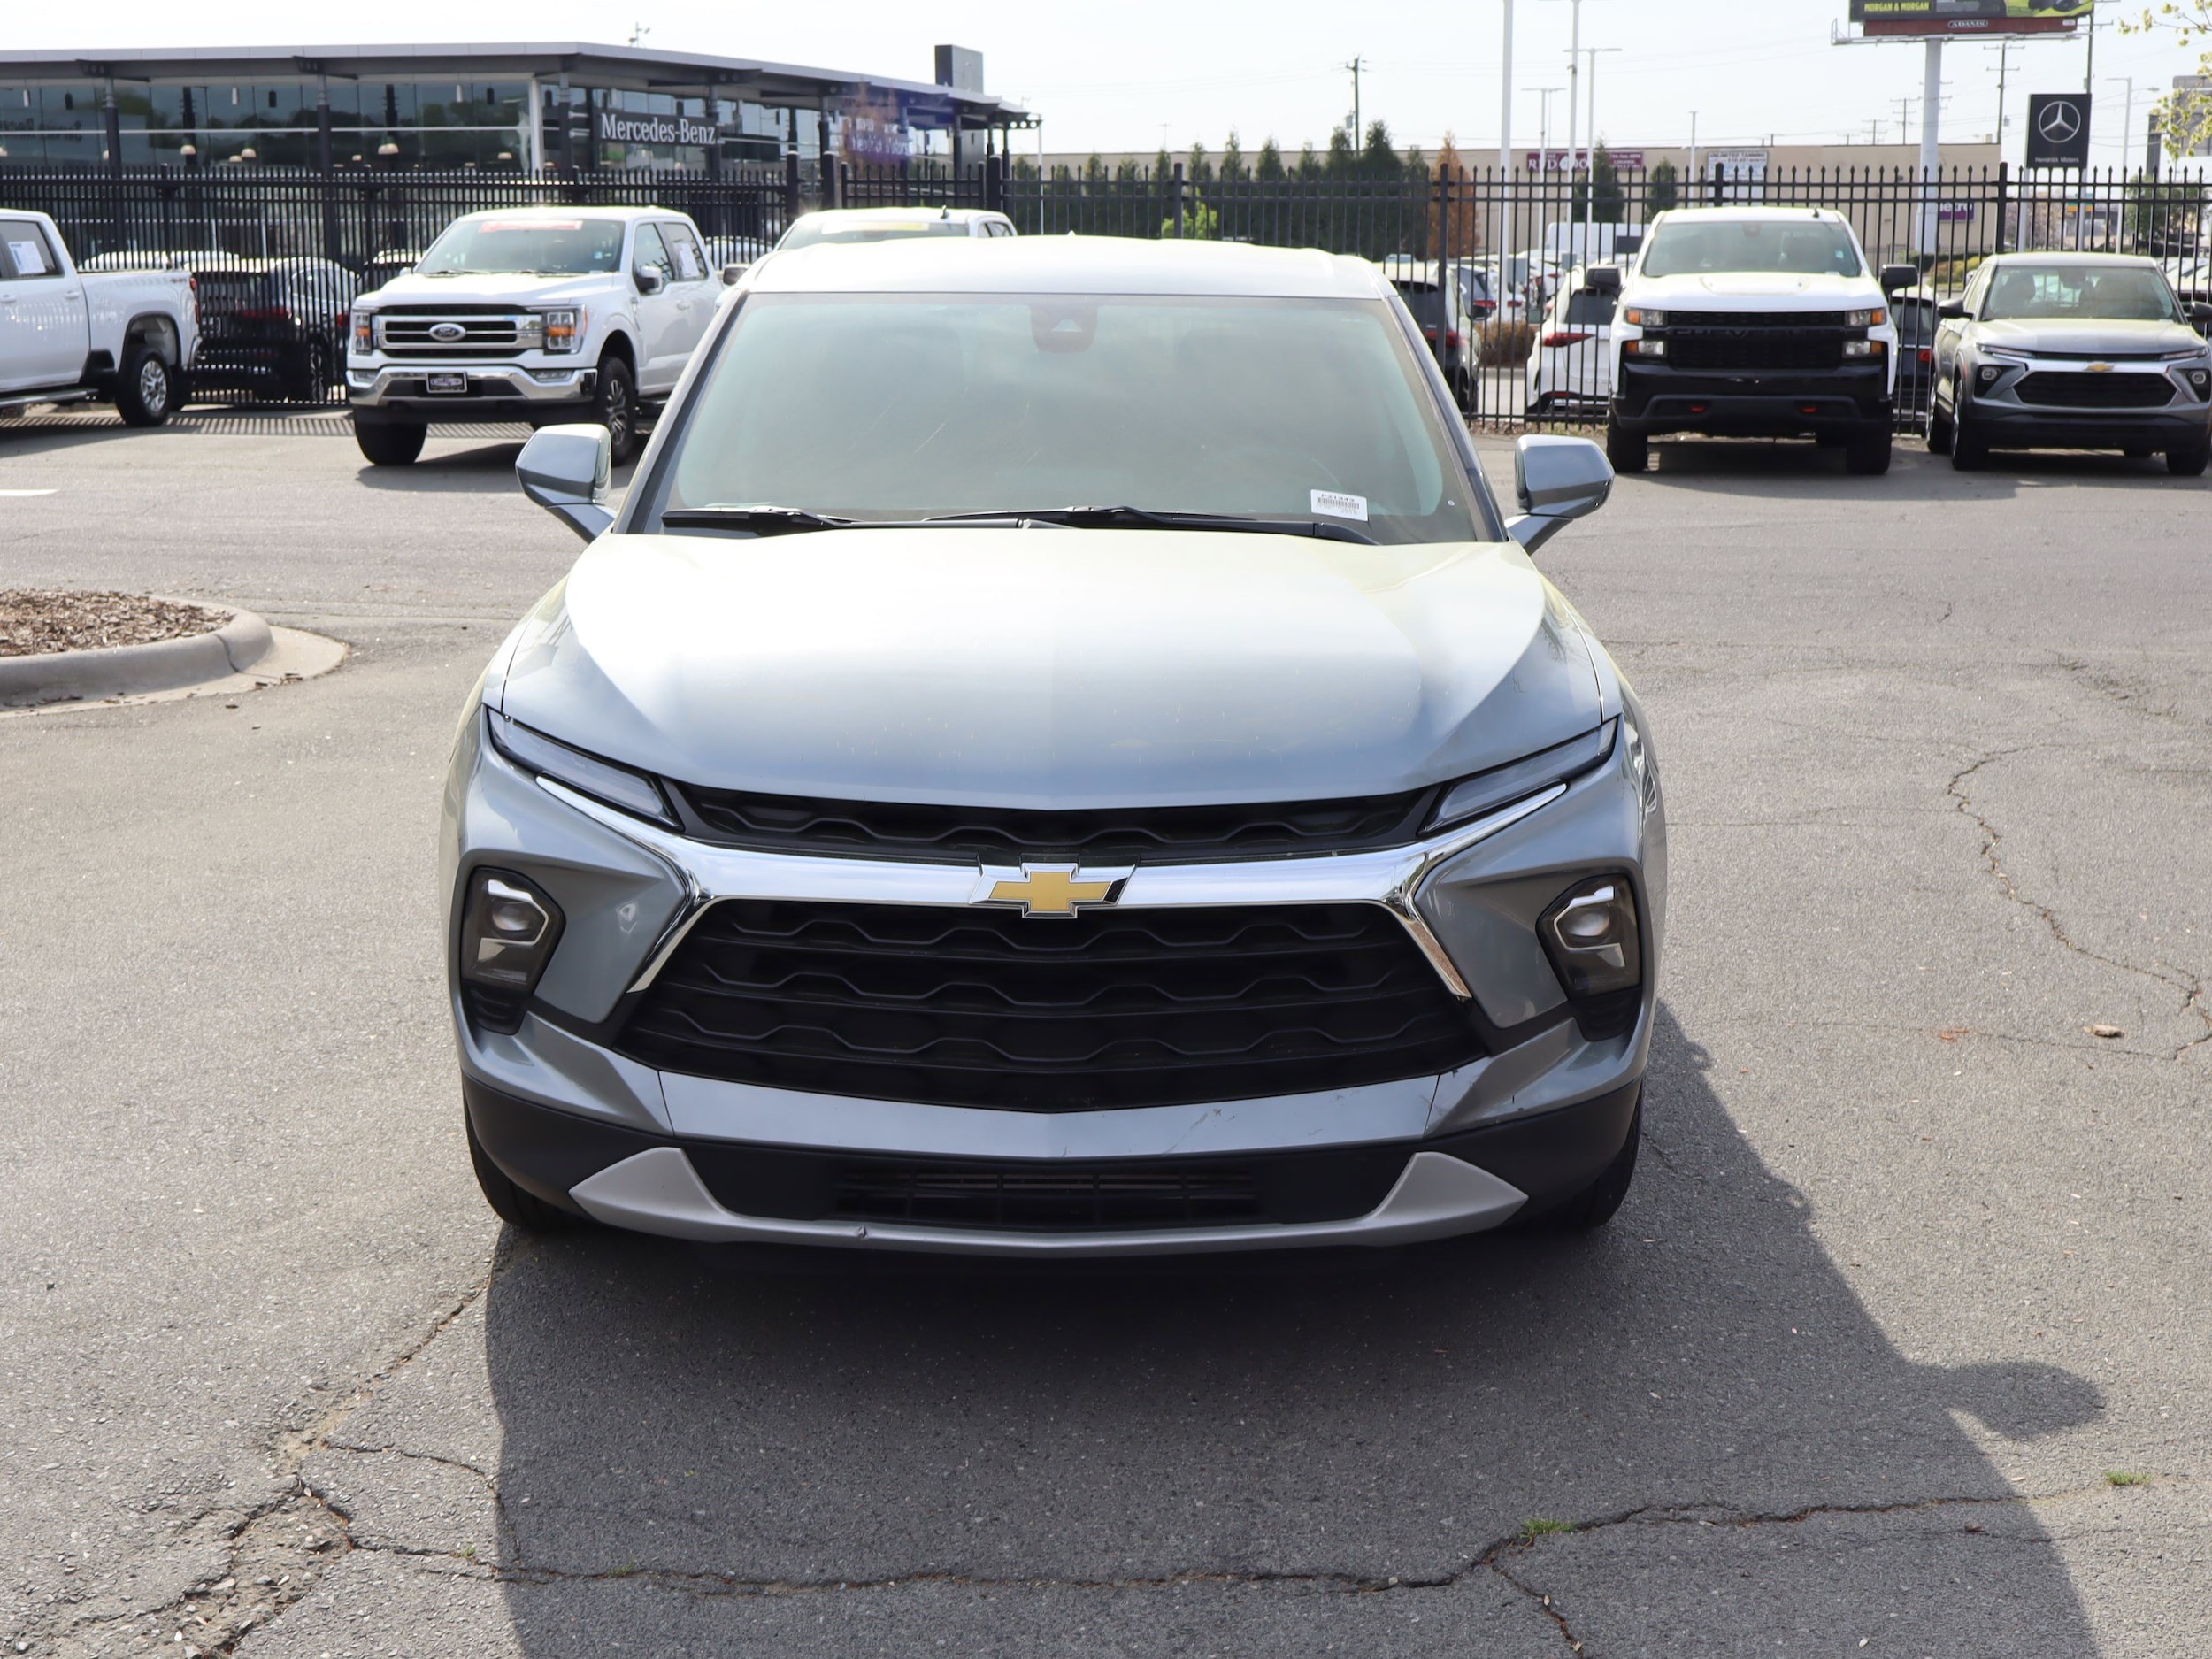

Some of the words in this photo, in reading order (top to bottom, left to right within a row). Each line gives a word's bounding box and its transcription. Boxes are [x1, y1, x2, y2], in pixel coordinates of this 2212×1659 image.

[1864, 3, 1893, 12] MORGAN
[1901, 2, 1929, 11] MORGAN
[602, 112, 716, 144] Mercedes-Benz
[1528, 159, 1557, 169] RD
